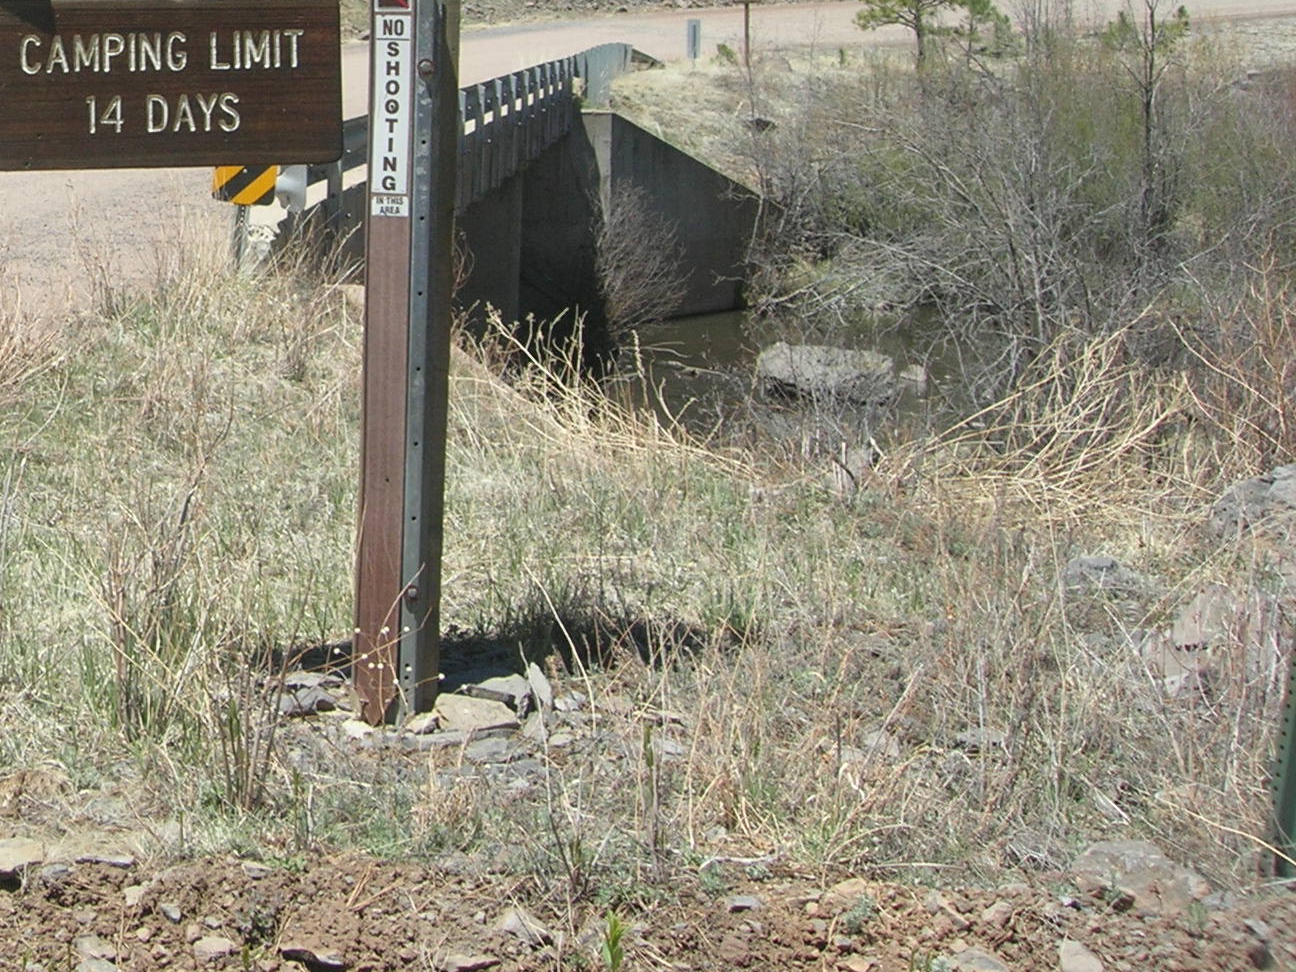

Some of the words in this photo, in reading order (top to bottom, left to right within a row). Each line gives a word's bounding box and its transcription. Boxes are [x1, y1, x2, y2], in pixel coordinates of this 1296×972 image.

[383, 19, 405, 36] NO
[19, 31, 188, 74] CAMPING
[209, 29, 305, 70] LIMIT
[86, 95, 125, 134] 14
[146, 92, 241, 133] DAYS
[376, 195, 384, 205] IN
[386, 195, 404, 205] THIS
[379, 206, 401, 214] AREA
